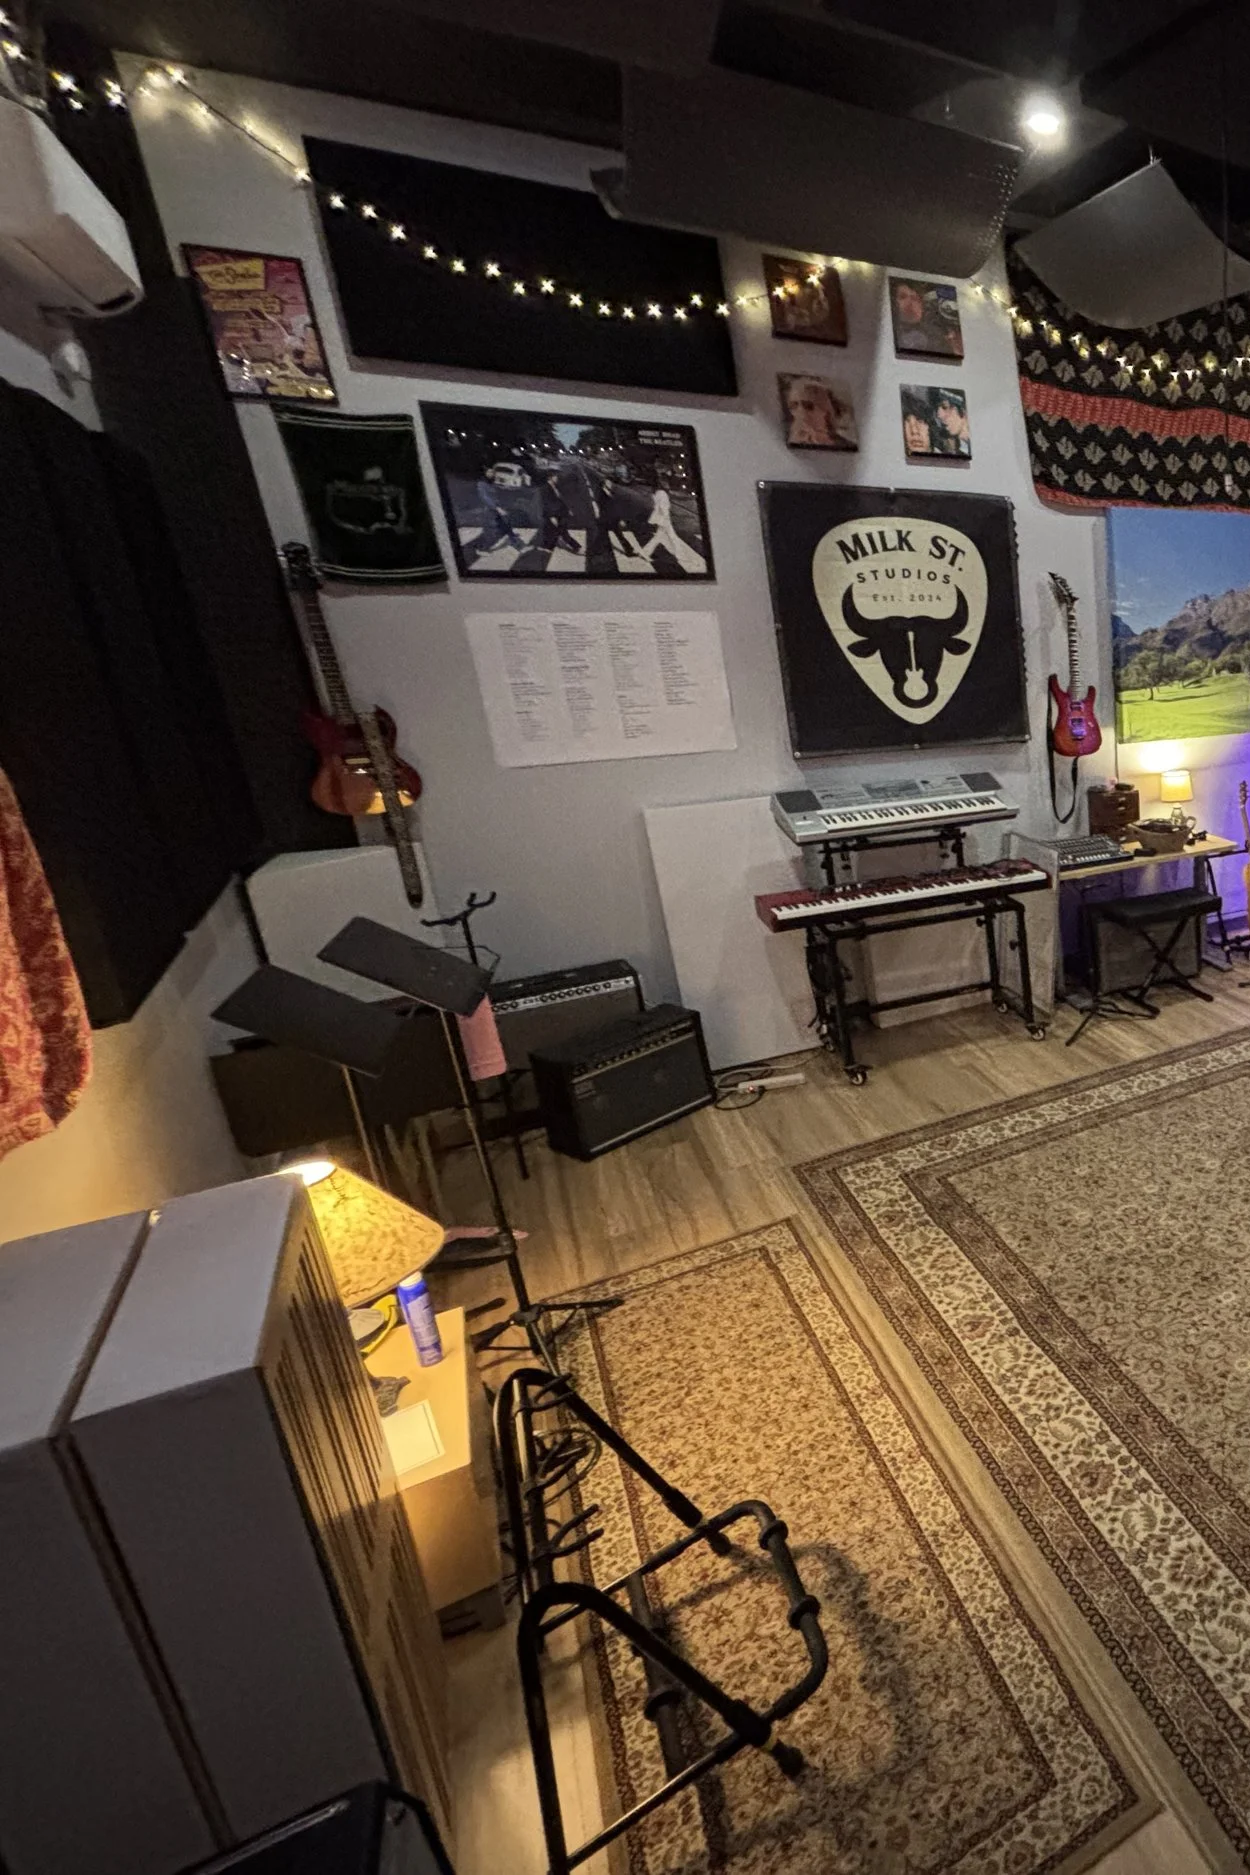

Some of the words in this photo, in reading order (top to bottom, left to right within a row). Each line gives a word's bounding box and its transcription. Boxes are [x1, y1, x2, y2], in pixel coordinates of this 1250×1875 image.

[836, 529, 917, 565] MILK
[928, 535, 966, 572] ST.
[856, 568, 951, 584] STUDIOS
